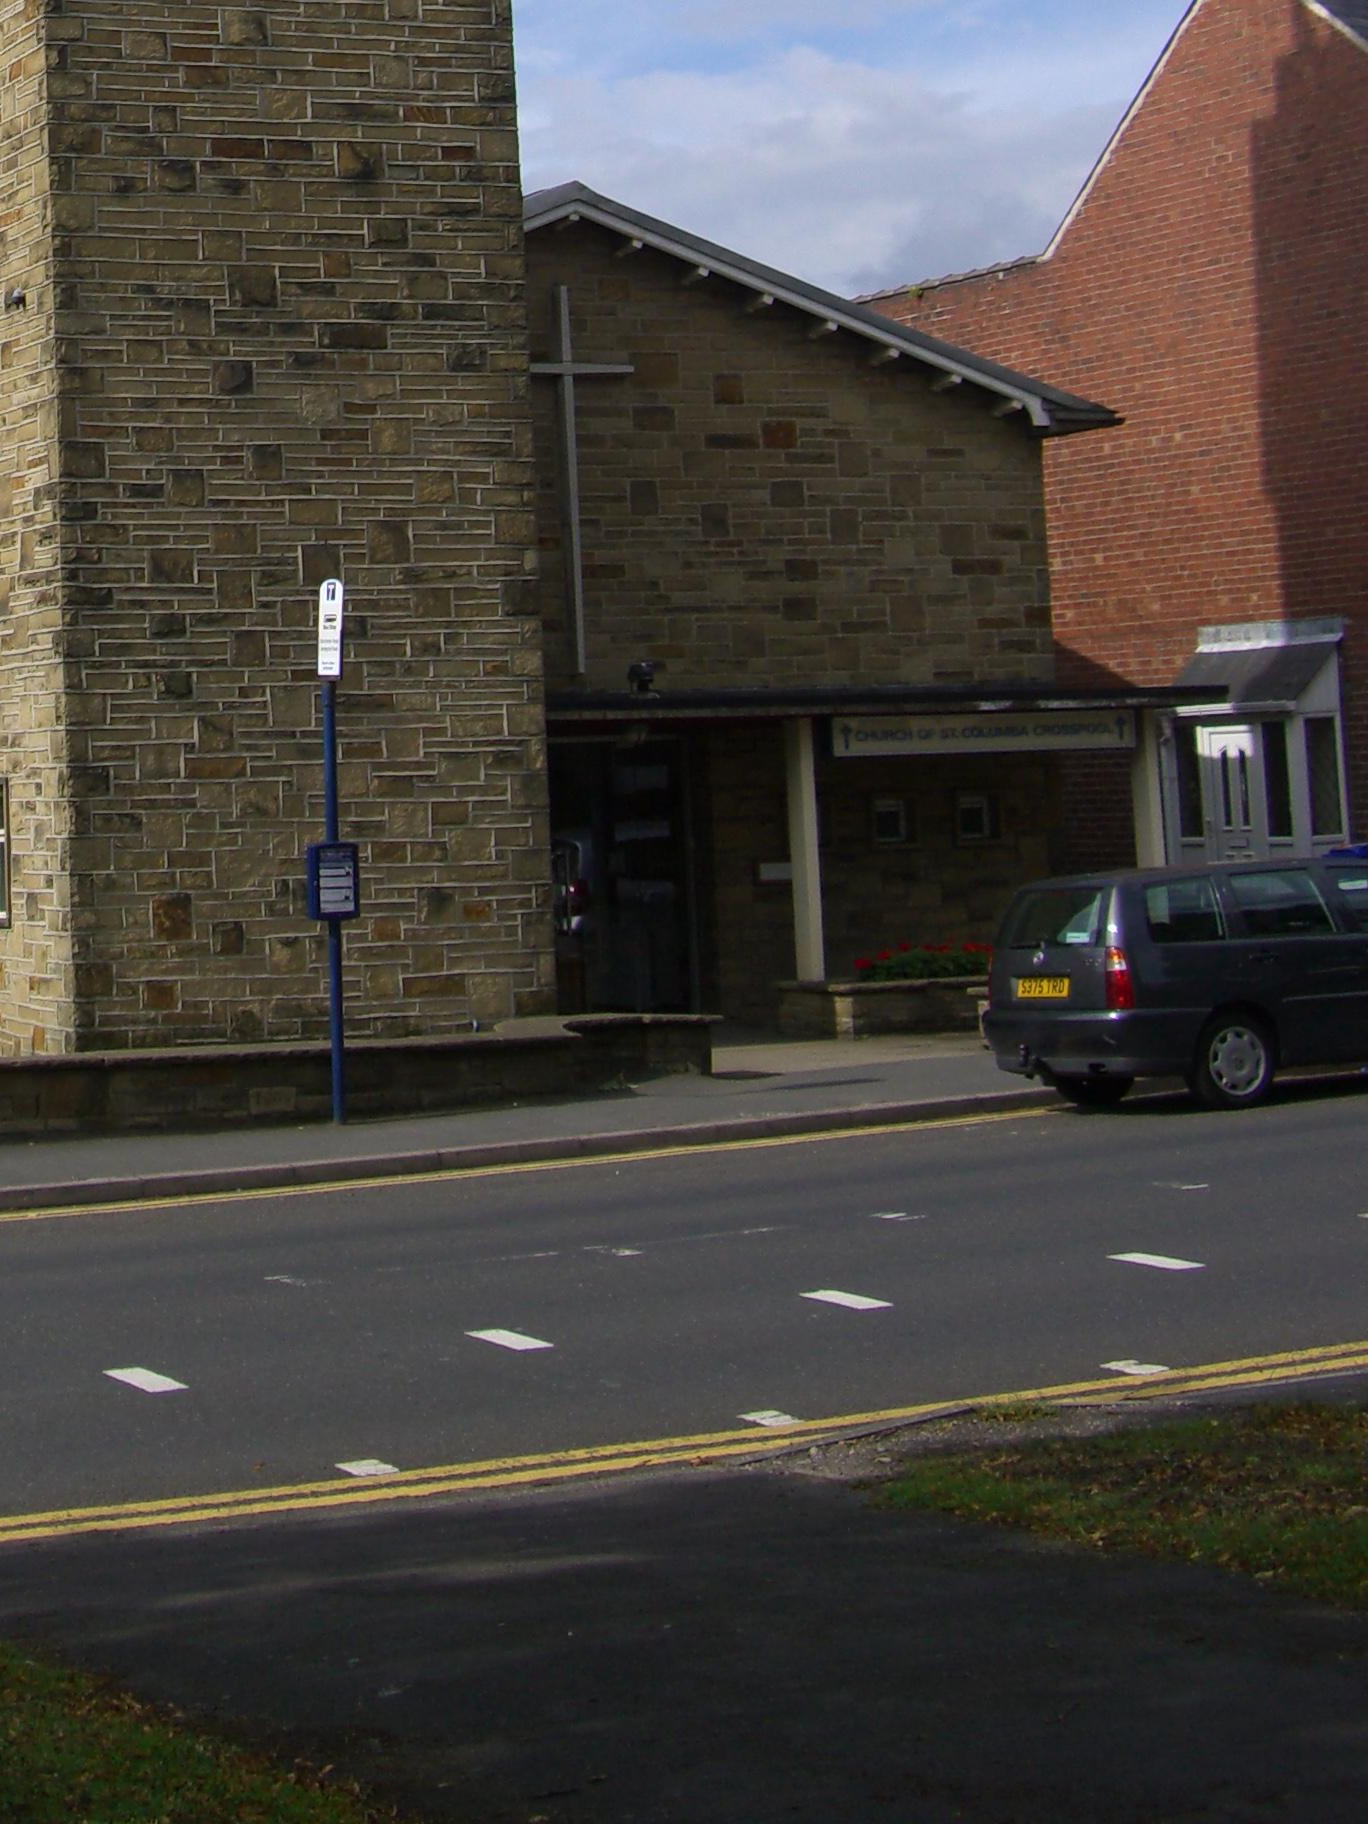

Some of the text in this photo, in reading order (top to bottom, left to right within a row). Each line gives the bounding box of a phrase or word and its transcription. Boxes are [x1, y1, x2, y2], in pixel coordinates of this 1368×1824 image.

[855, 729, 912, 742] CHURCH
[917, 728, 936, 740] OF
[961, 725, 1029, 739] COLUMBA
[1032, 723, 1114, 737] CROSSPOOL
[1021, 978, 1065, 994] S375 TRD
